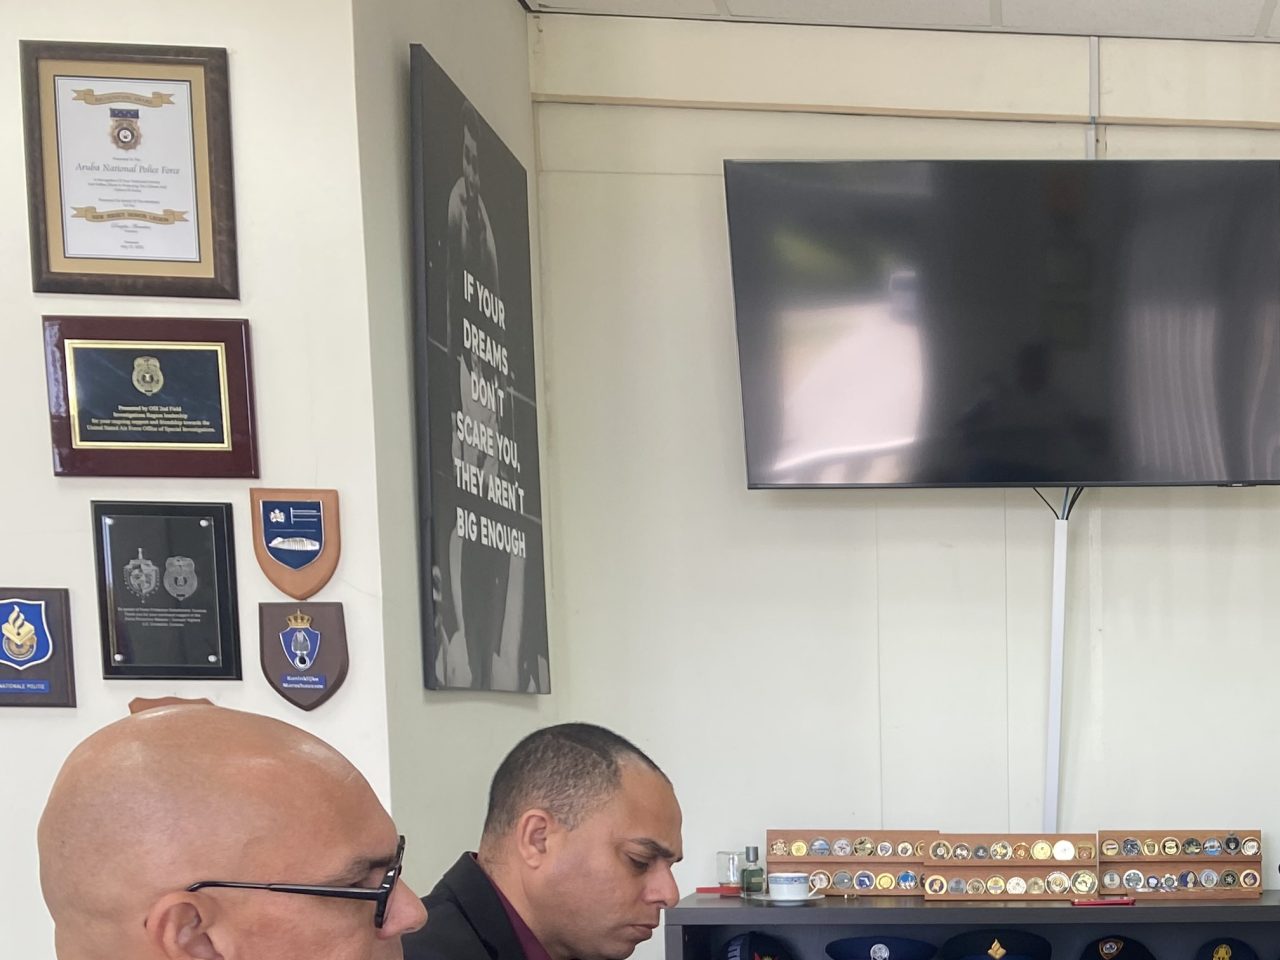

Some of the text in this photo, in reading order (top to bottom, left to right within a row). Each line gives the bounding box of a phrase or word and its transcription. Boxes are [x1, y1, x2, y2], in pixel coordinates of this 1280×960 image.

[463, 270, 506, 330] IF YOUR
[463, 318, 508, 375] DREAMS
[471, 371, 504, 417] DON'T
[457, 410, 521, 473] SCARE YOU,
[454, 457, 525, 515] THEY AREN'T
[456, 506, 527, 559] BIG ENOUGH
